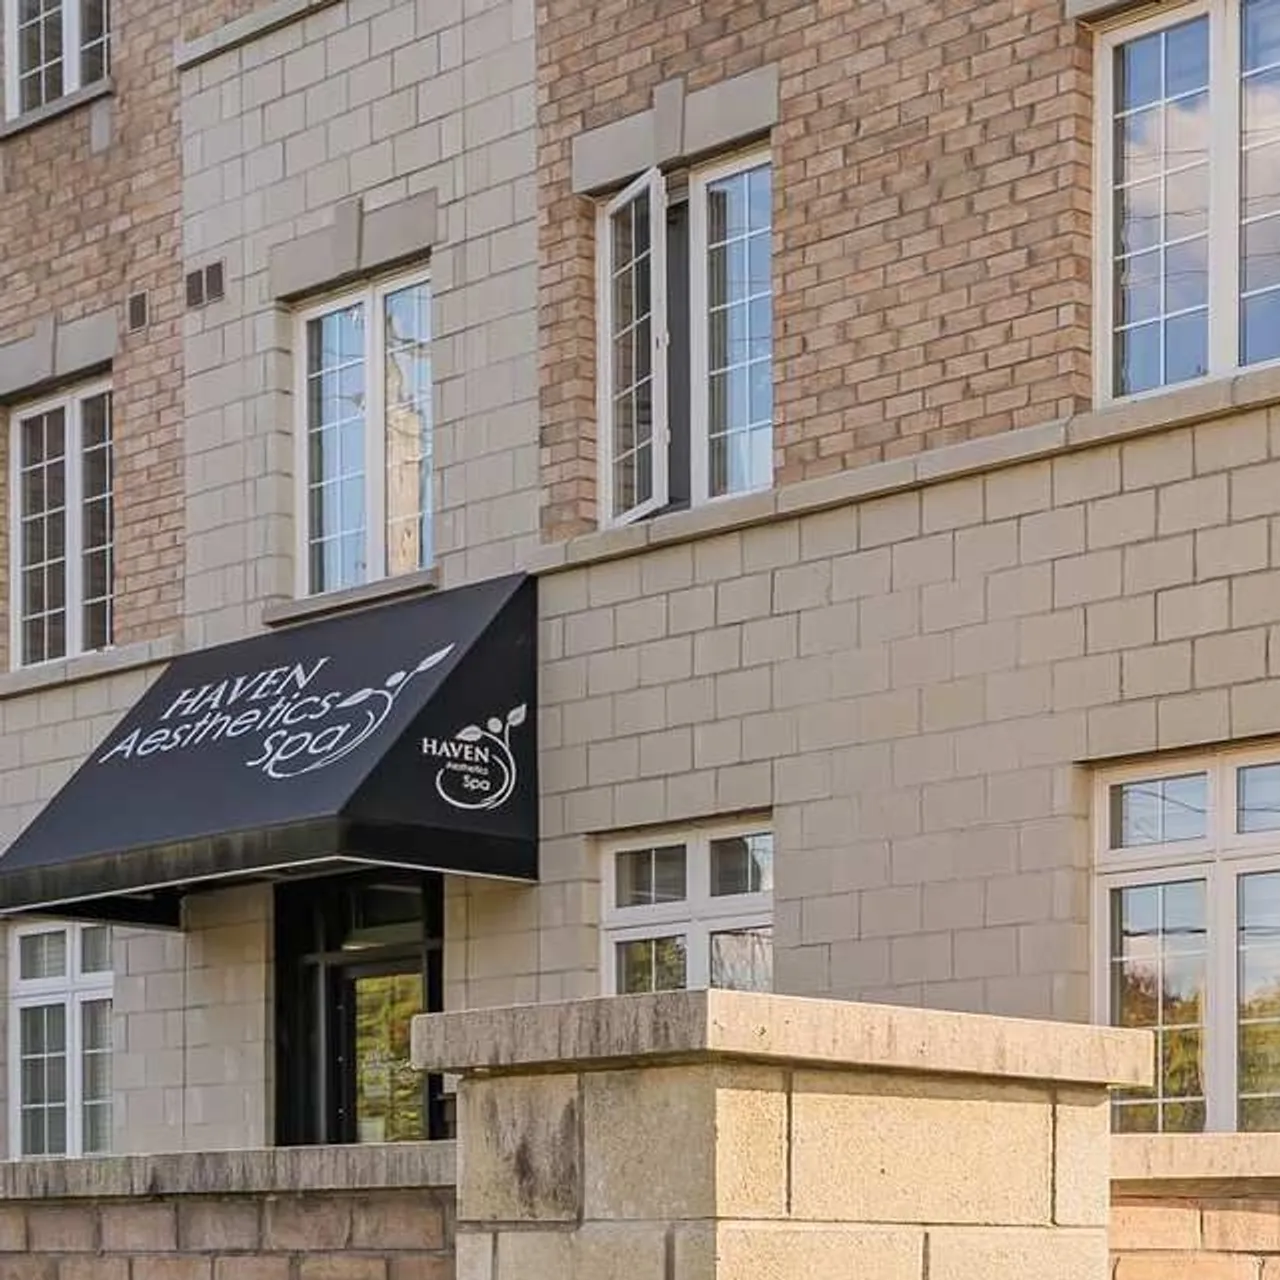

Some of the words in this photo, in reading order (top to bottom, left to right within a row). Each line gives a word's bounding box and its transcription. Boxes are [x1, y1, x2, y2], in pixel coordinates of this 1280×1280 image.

[161, 656, 331, 720] HAVEN
[99, 691, 342, 763] Aesthetics
[422, 737, 490, 763] HAVEN
[463, 774, 491, 791] Spa
